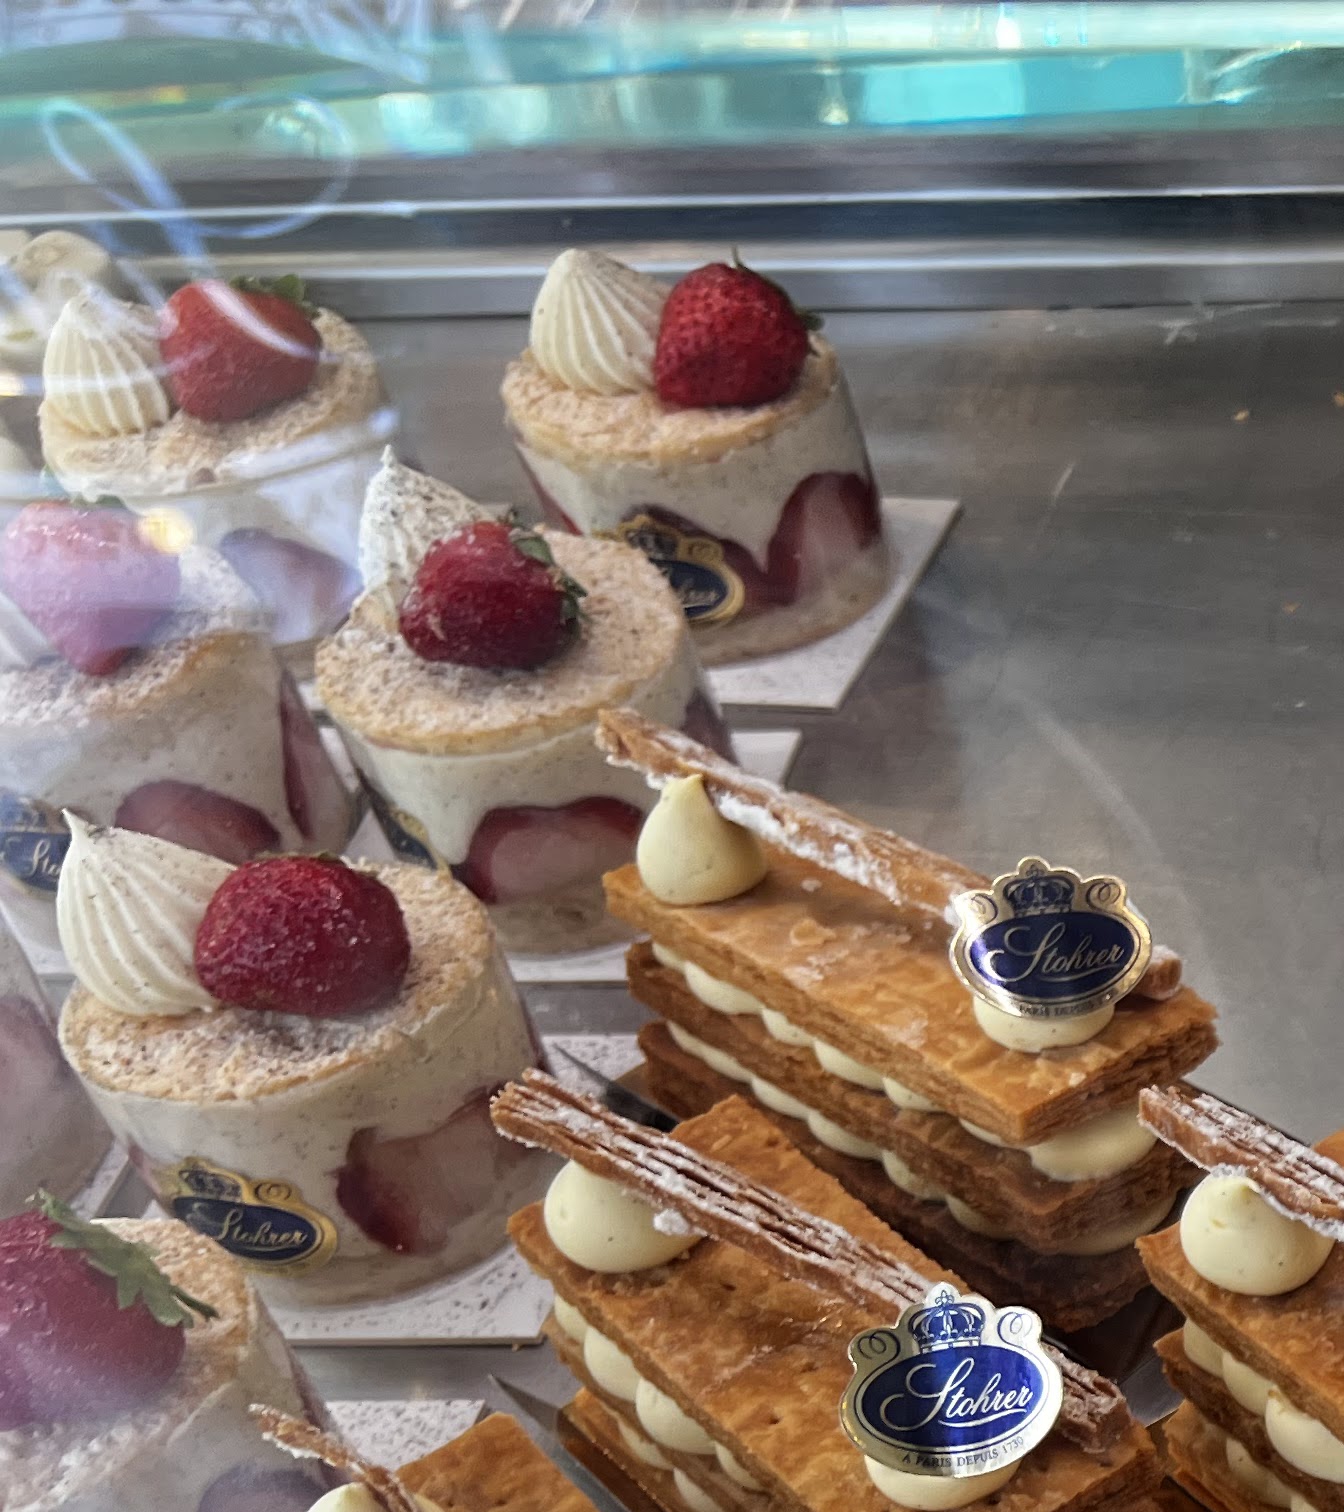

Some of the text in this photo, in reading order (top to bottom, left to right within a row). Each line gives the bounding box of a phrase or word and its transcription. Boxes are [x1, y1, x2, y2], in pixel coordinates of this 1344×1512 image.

[983, 922, 1125, 983] Stohrer
[880, 1358, 1034, 1432] Stohrer
[916, 1454, 952, 1468] PARIS
[957, 1450, 999, 1468] DEPUIS
[1002, 1436, 1025, 1456] 1730
